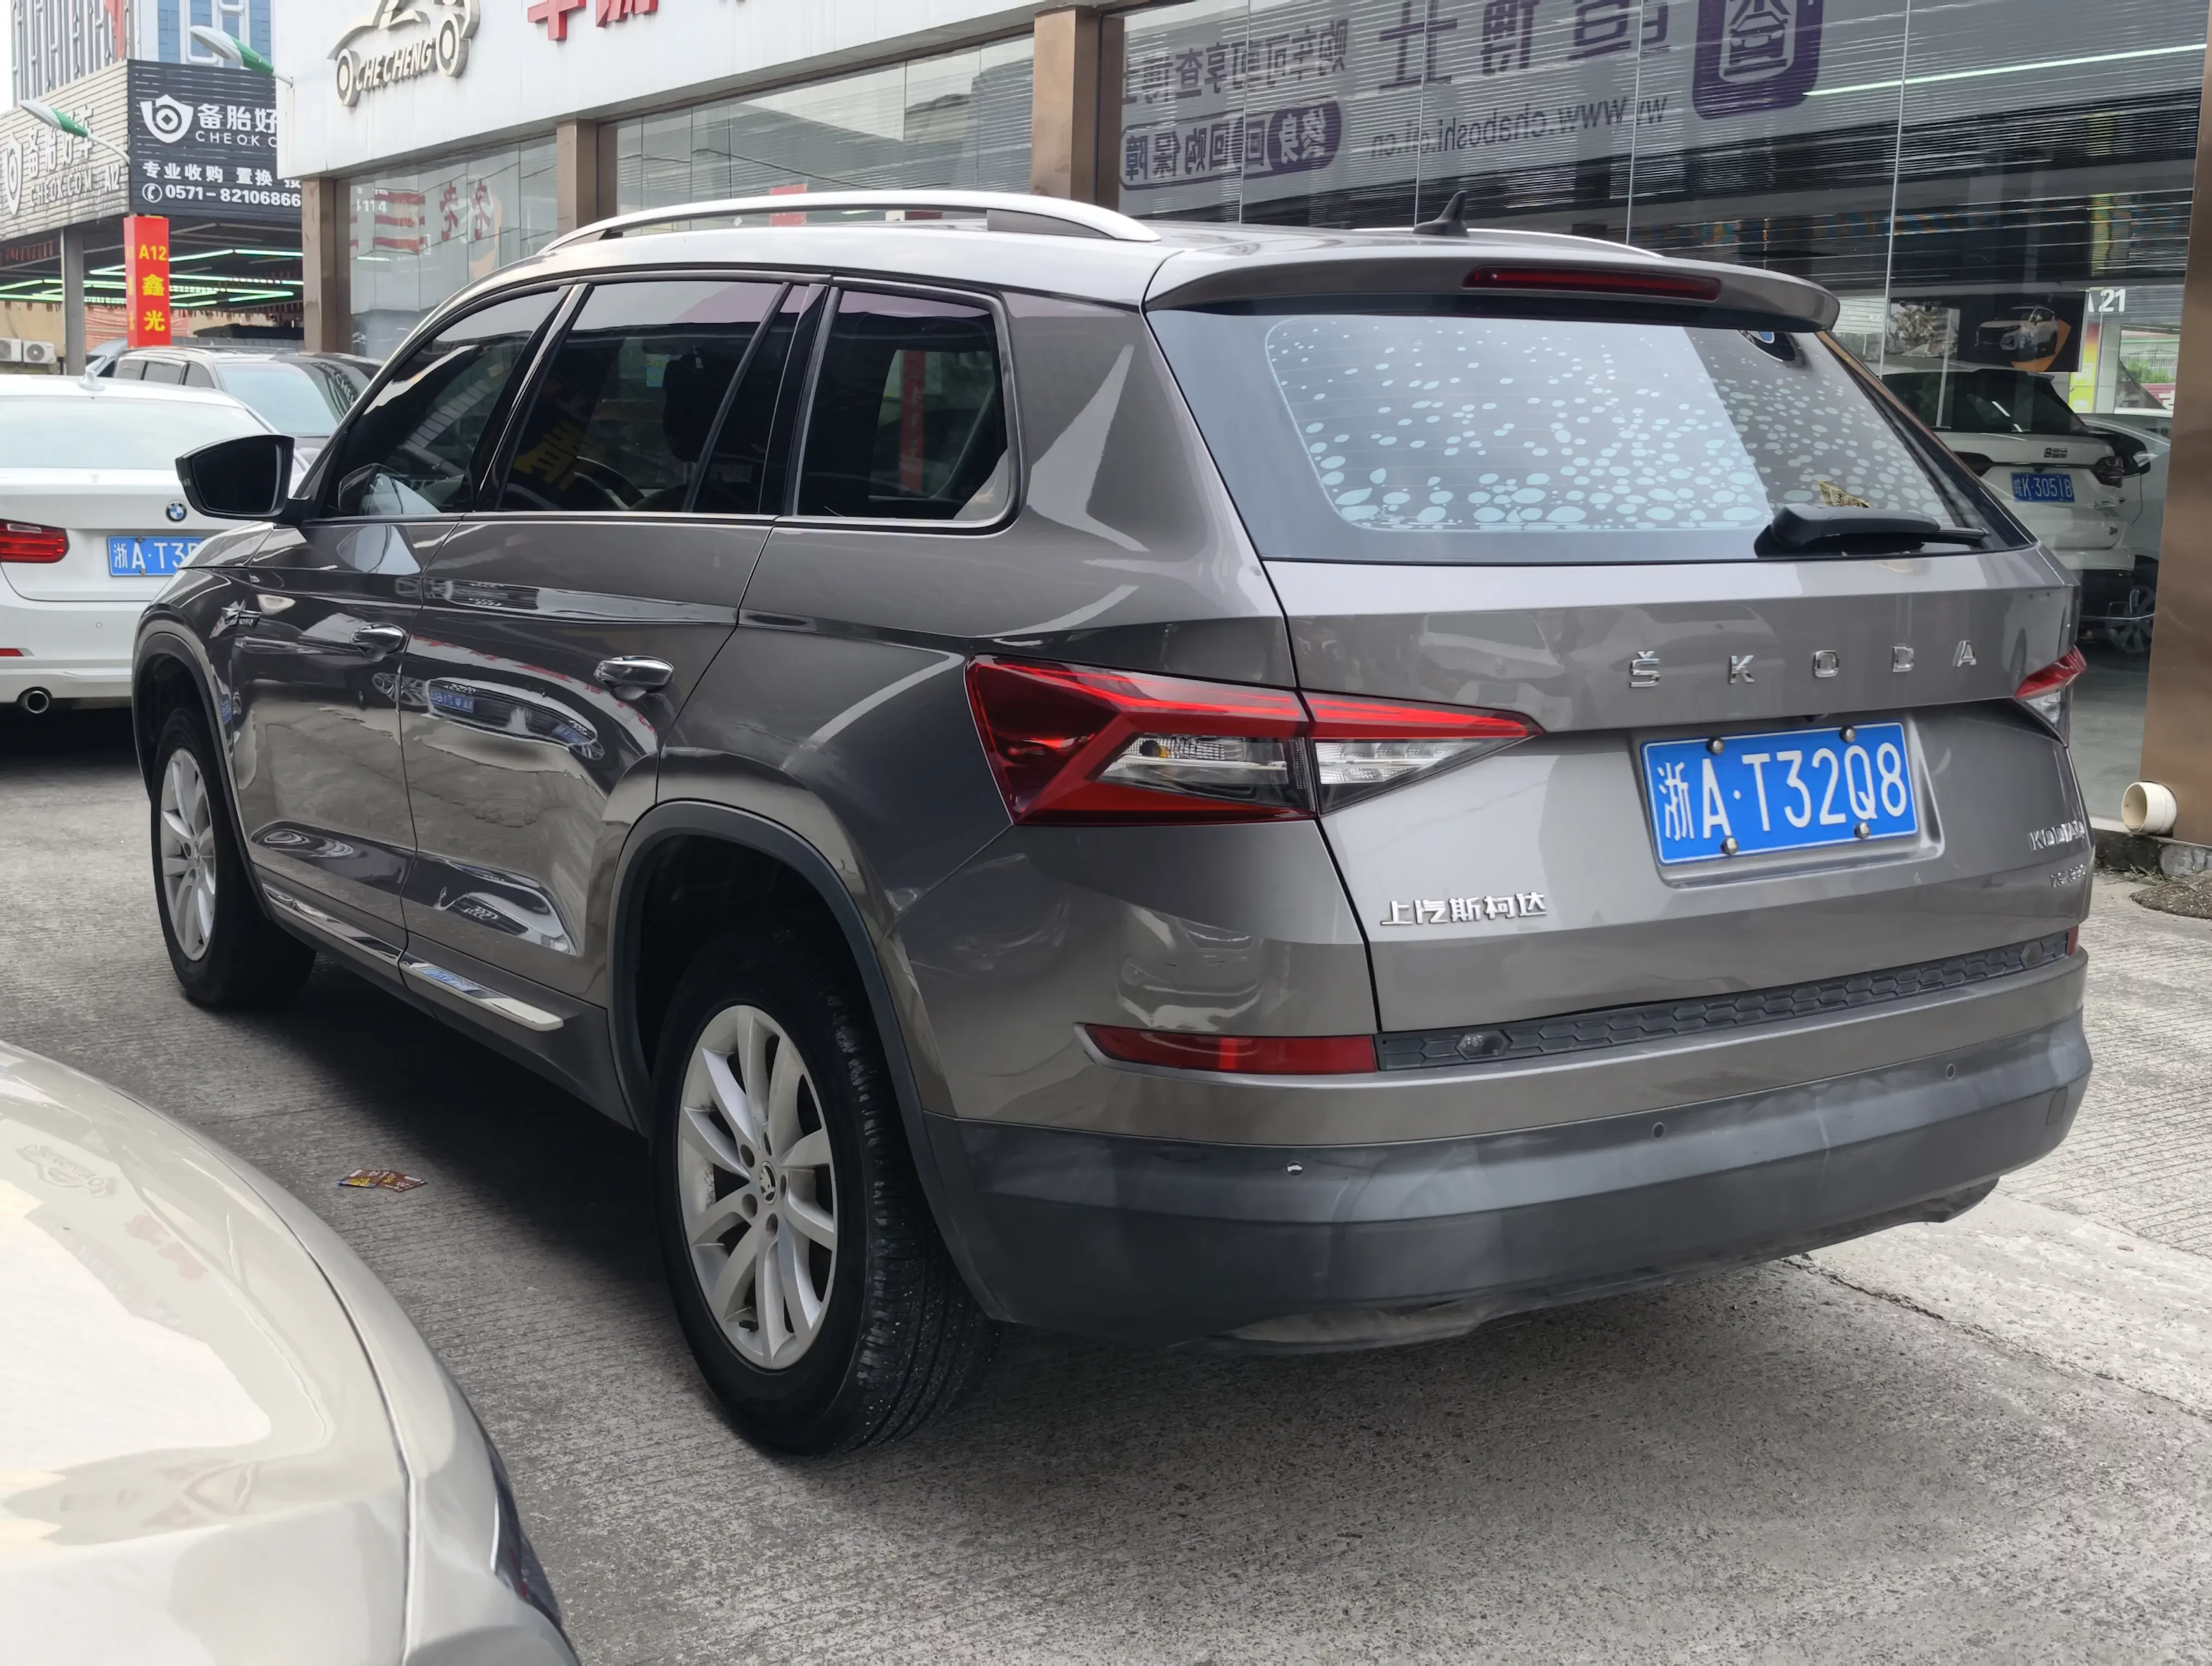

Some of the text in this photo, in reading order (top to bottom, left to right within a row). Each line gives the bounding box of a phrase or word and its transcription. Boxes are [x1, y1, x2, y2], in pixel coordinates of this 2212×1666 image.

[142, 161, 223, 183] 专业收购
[236, 167, 273, 187] 置换
[165, 184, 301, 207] 0571-82106866
[139, 244, 167, 261] A12
[142, 273, 166, 332] 鑫光
[113, 542, 196, 569] 浙A·T3
[1657, 742, 1907, 842] 浙A·T32Q8
[1380, 892, 1548, 926] 上汽斯柯达
